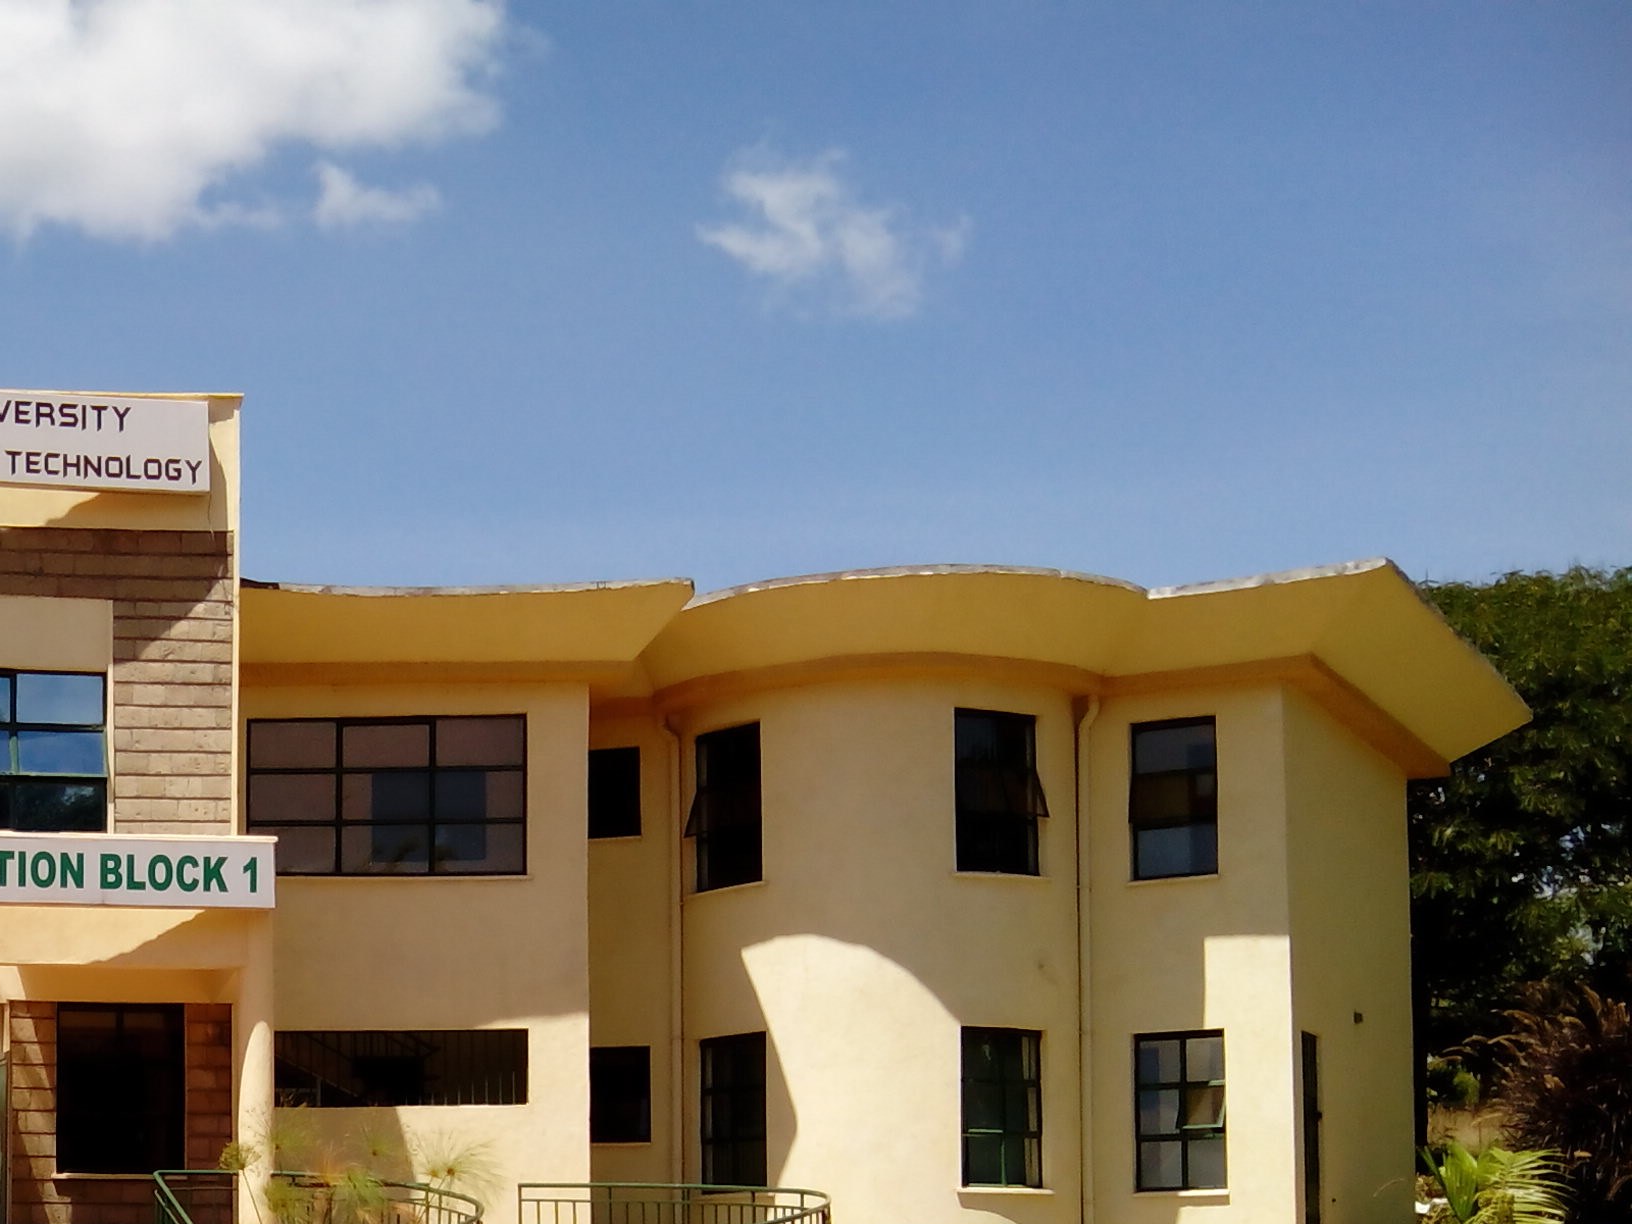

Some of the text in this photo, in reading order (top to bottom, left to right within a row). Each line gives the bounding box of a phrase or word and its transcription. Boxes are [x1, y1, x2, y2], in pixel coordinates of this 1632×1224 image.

[6, 449, 202, 485] TECHNOLOGY
[99, 852, 229, 893] BLOCK
[242, 857, 259, 893] 1
